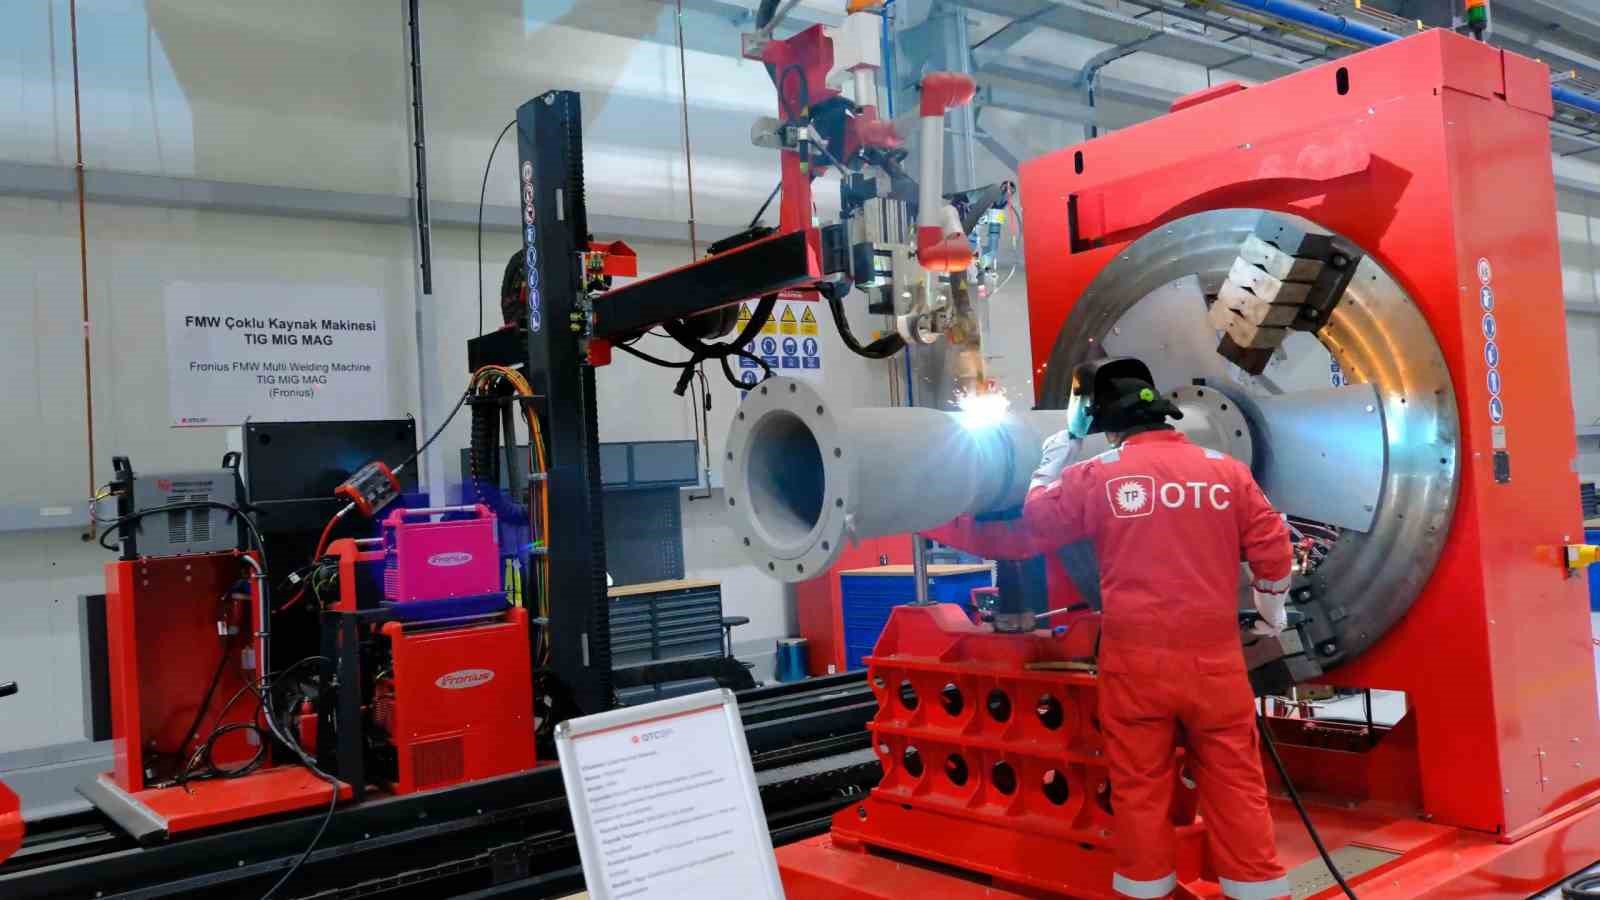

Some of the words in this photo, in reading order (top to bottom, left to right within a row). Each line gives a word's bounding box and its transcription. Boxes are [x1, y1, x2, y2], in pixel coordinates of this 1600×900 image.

[185, 315, 221, 328] FMW
[225, 316, 265, 330] Çoklu
[269, 317, 317, 331] Kaynak
[321, 319, 376, 331] Makinesi
[244, 333, 268, 345] TIG
[271, 333, 298, 346] MIG
[302, 334, 333, 346] MAG
[189, 361, 230, 372] Fronius
[232, 361, 260, 372] FMW
[289, 362, 329, 374] Welding
[331, 362, 371, 373] Machine
[256, 375, 276, 385] TIG
[278, 375, 300, 385] MIG
[302, 375, 328, 385] MAG
[269, 387, 314, 399] (Fronius)
[1124, 490, 1139, 503] TP
[1160, 481, 1232, 511] OTC
